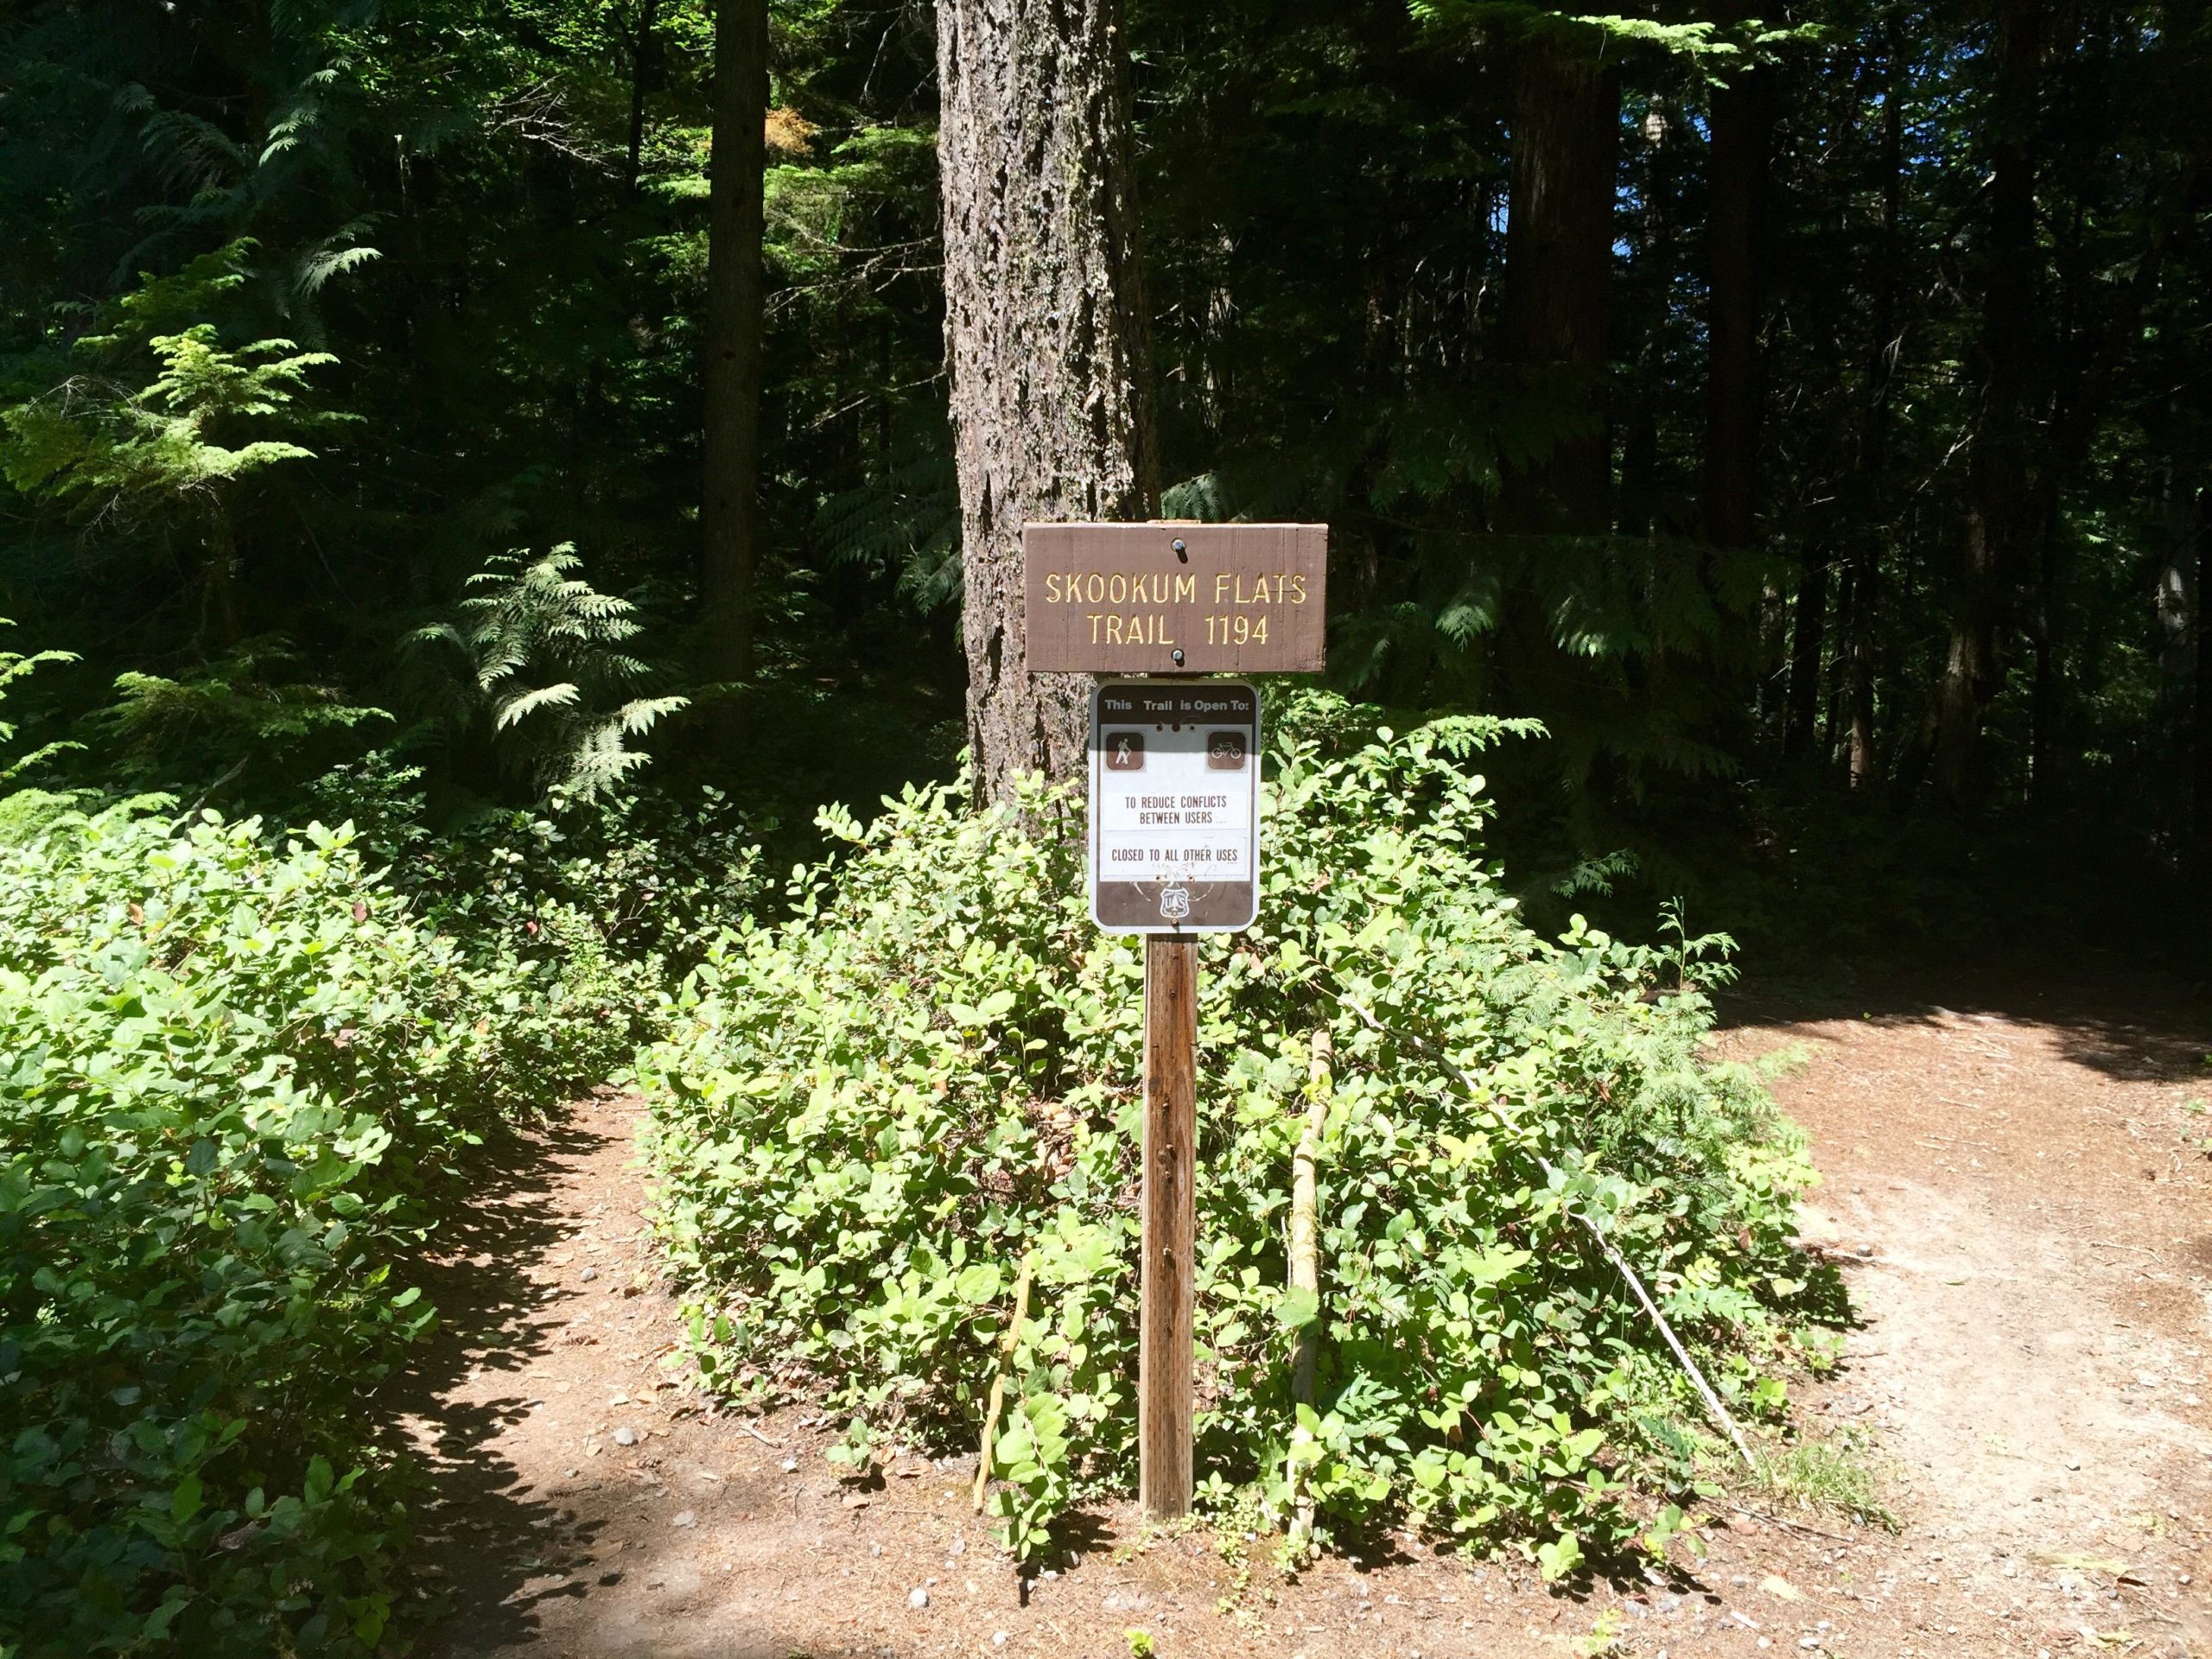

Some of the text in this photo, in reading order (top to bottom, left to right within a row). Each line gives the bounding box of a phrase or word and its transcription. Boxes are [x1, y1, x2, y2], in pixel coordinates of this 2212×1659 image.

[1046, 573, 1307, 604] SKOOKUM FLATS
[1086, 614, 1268, 645] TRAIL 1194
[1104, 699, 1249, 713] This Trail is Open To:
[1125, 795, 1227, 809] TO REDUCE CONFLICTS
[1140, 811, 1212, 824] BETWEEN USERS
[1111, 849, 1237, 861] CLOSED TO ALL OTHER USES
